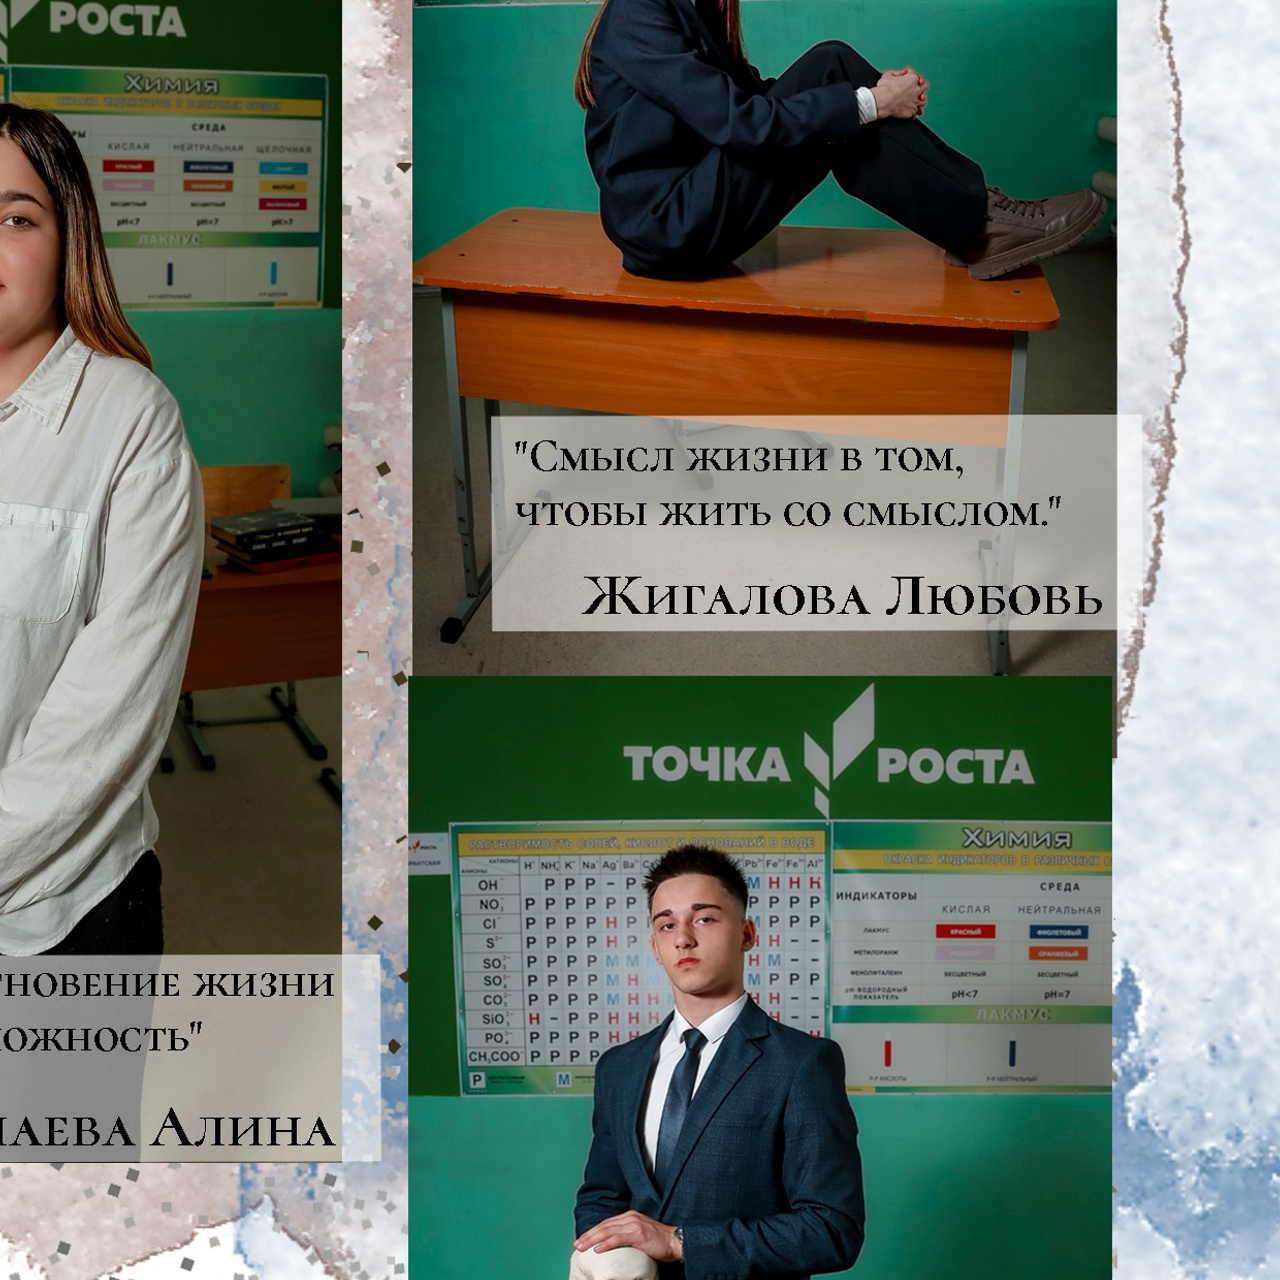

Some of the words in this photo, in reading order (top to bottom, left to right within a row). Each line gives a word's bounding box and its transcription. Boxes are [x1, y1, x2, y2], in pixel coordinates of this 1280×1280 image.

[50, 2, 187, 38] РОСТА
[124, 73, 220, 94] Химия
[192, 123, 226, 132] СРЕДА
[108, 143, 150, 151] КИСЛАЯ
[138, 234, 203, 245] ЛАКМУС
[623, 745, 791, 783] ТОЧКА
[877, 748, 1035, 786] РОСТА
[469, 839, 573, 850] РАСТВОРИМОСТЬ
[626, 838, 672, 848] КИСЛОТ
[770, 837, 778, 847] В
[783, 837, 815, 848] ВОДЕ
[962, 827, 1073, 849] Химия
[884, 854, 932, 865] ОКРАСКА
[938, 854, 1016, 866] ИНДИКАТОРОВ
[1035, 855, 1099, 866] РАЗЛИЧНЫХ
[1040, 882, 1080, 892] СРЕДА
[836, 891, 917, 901] ИНДИКАТОРЫ
[942, 904, 991, 914] КИСЛАЯ
[1018, 904, 1101, 915] НЕЙТРАЛЬНАЯ
[950, 927, 982, 936] КРАСНЫЙ
[1036, 928, 1082, 937] ФИОЛЕТОВЫЙ
[951, 990, 978, 999] pH<7
[1044, 990, 1071, 1000] pH=7
[976, 1008, 1052, 1021] ЛАКМУС
